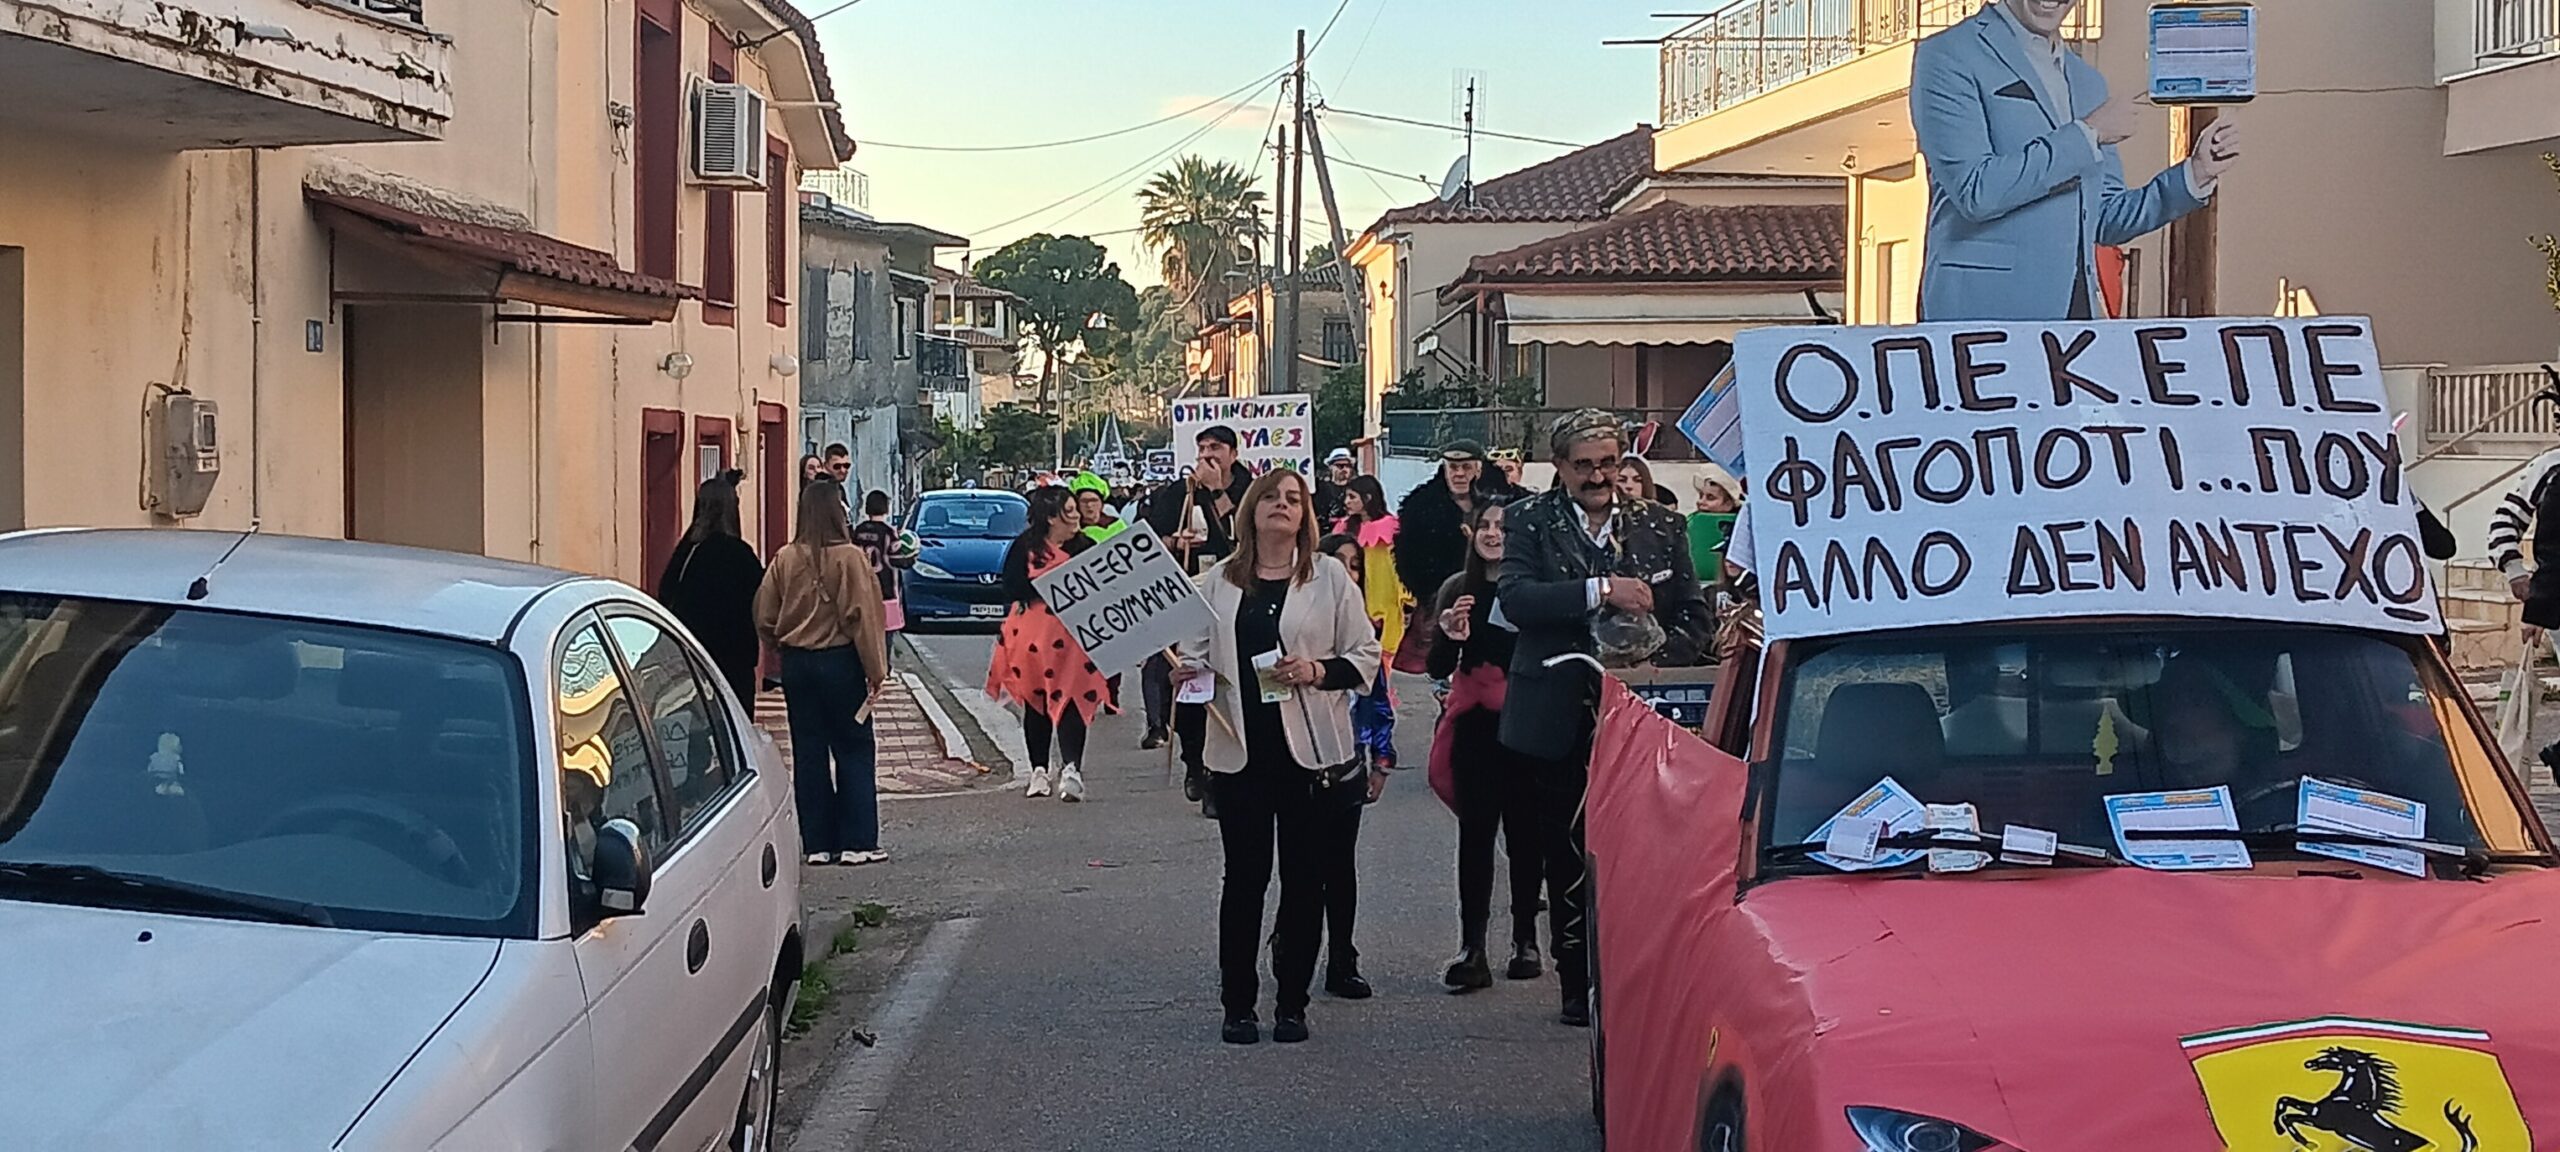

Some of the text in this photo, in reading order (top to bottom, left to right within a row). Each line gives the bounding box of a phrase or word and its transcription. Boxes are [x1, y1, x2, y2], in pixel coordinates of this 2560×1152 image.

[1775, 325, 2381, 423] Ο.Π.Ε.Κ.Ε.Π.Ε
[1237, 427, 1303, 449] ΥΛΕΣ
[1243, 456, 1311, 477] ΝΟΥΜΕ
[1050, 565, 1100, 614] ΔΕΝ
[1774, 531, 1972, 615] ΑΛΛΟ
[2006, 517, 2146, 598] ΔΕΝ
